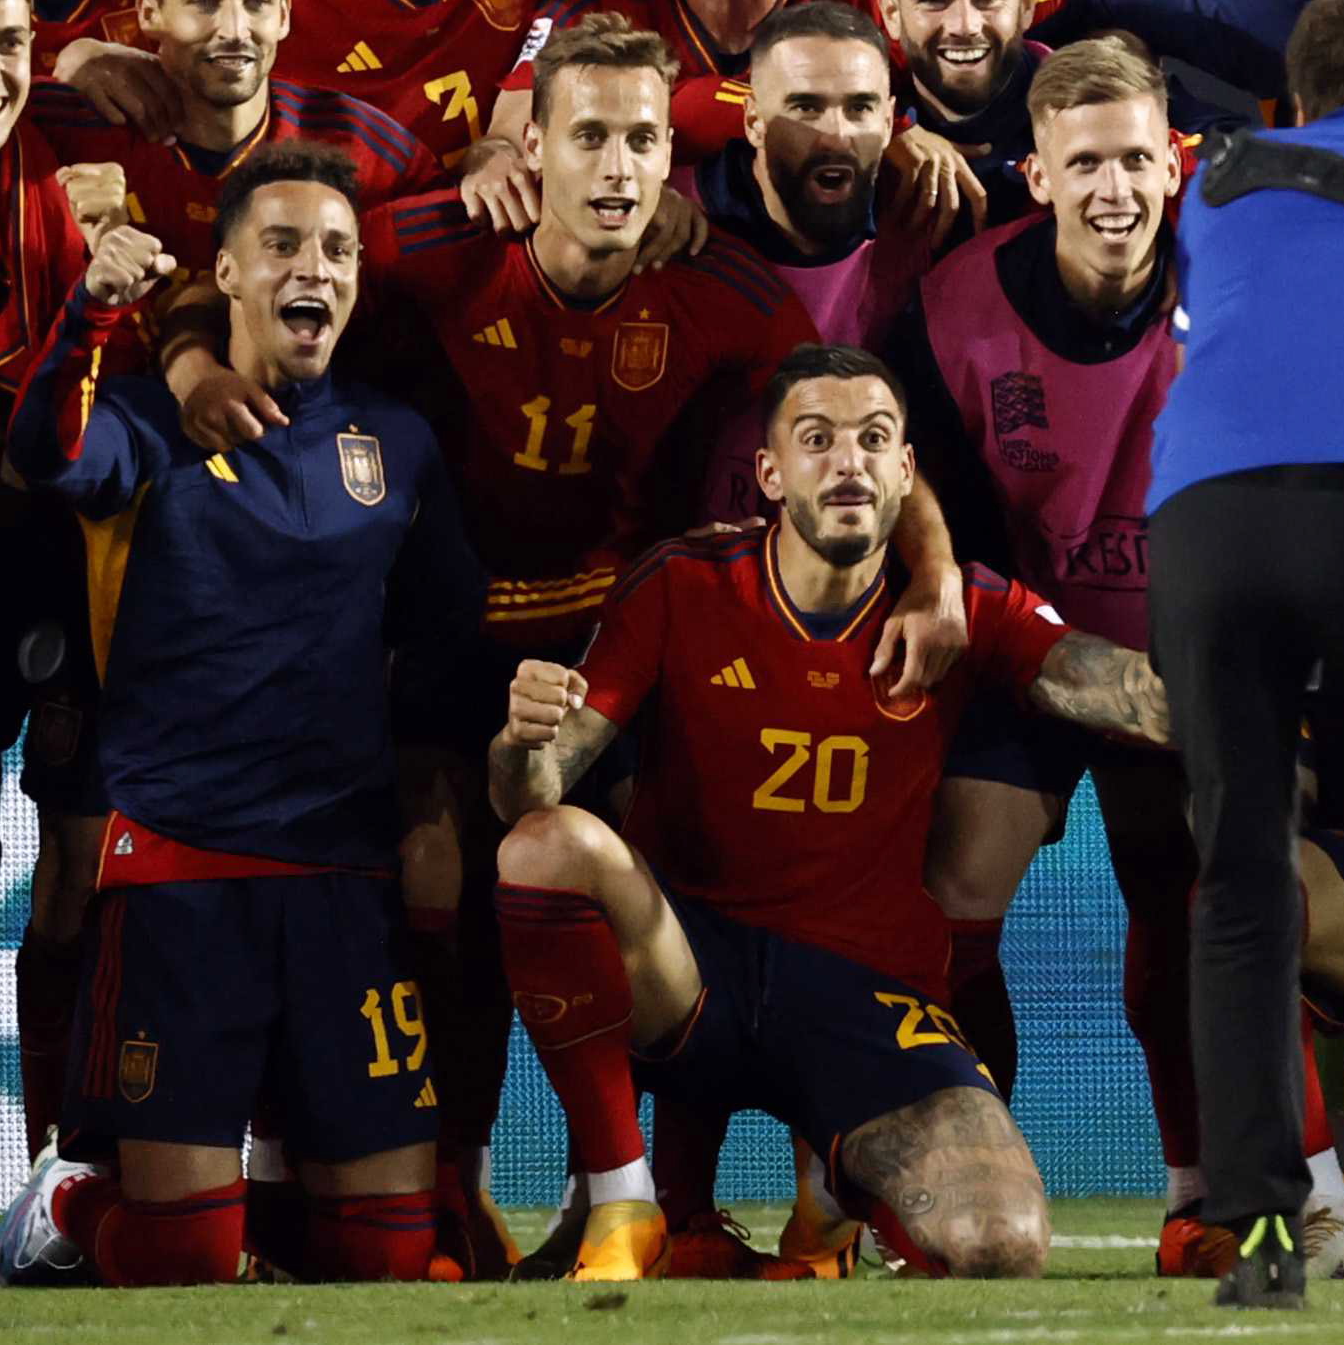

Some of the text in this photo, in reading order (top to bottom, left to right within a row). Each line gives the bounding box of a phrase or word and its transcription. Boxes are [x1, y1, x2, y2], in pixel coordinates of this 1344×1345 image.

[513, 395, 597, 474] 11
[751, 727, 869, 813] 20
[360, 980, 428, 1079] 19
